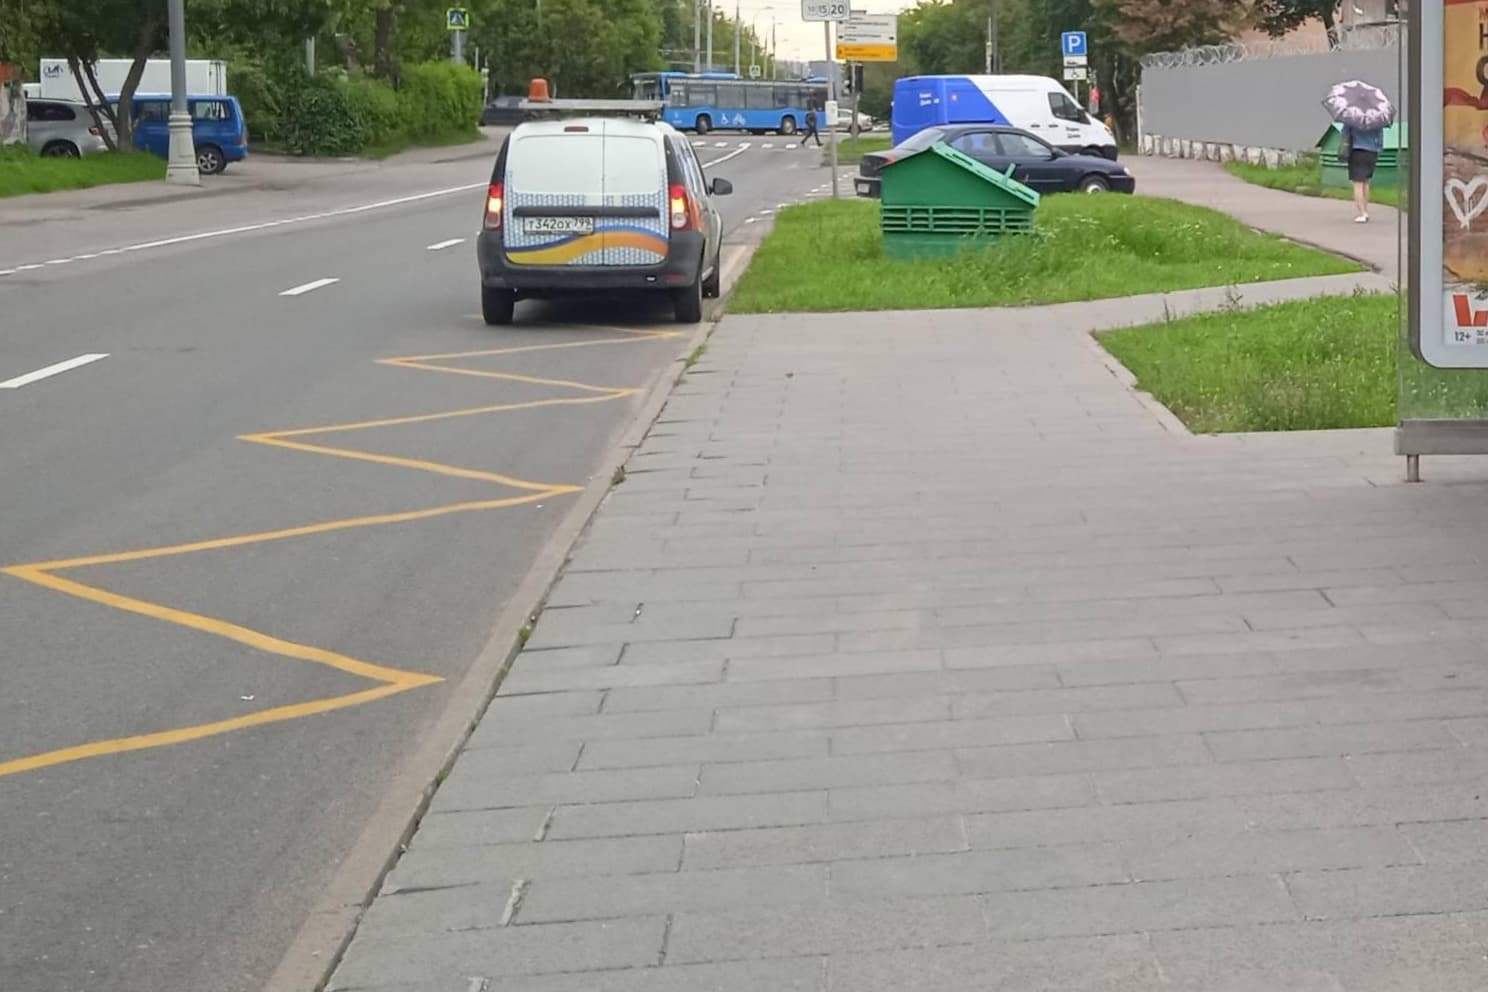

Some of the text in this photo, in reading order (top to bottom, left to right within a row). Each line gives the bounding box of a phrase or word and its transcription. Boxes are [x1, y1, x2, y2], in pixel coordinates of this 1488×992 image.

[830, 4, 845, 15] 20
[1068, 35, 1081, 53] P
[1454, 330, 1472, 342] 12+
